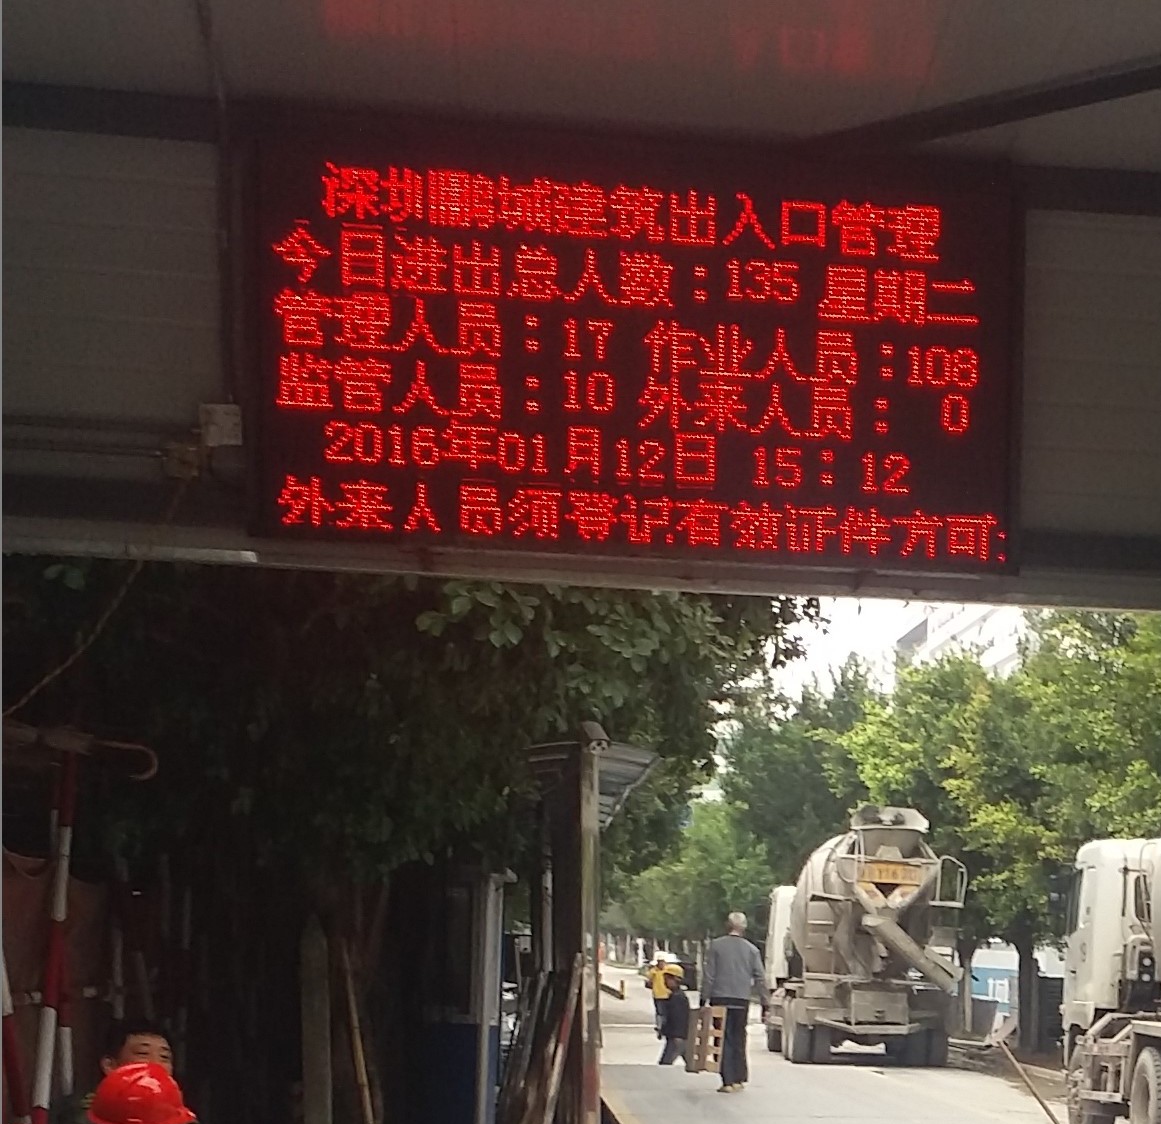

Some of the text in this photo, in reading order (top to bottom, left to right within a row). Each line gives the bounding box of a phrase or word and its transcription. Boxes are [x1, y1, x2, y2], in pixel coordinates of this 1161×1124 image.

[321, 161, 941, 262] 深圳鹏城建筑出入口管理
[818, 265, 980, 328] 星期二
[324, 419, 717, 483] 2016年01月12日
[278, 474, 1007, 563] 外来人员须登记有效证件方可
